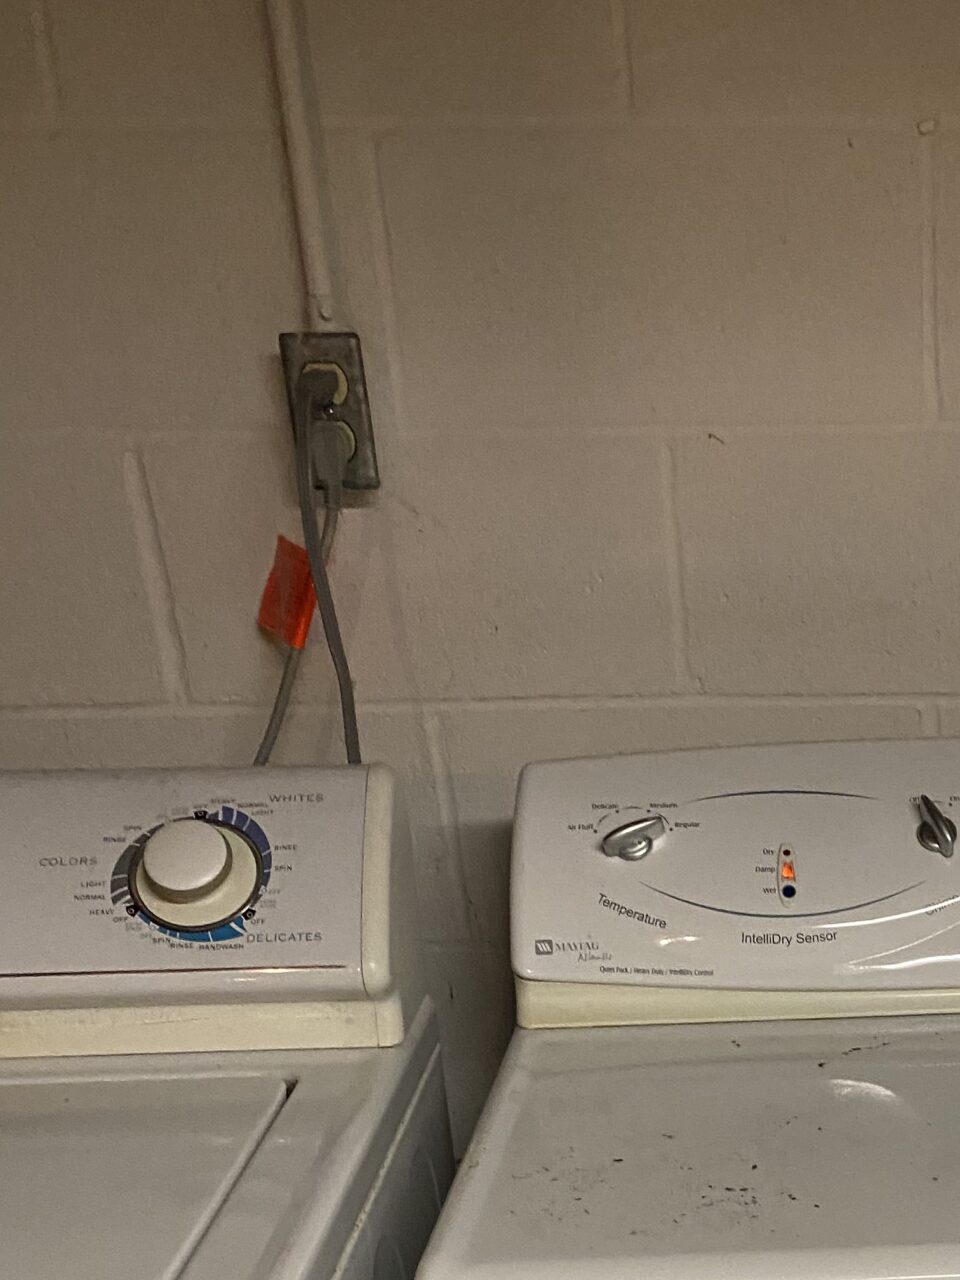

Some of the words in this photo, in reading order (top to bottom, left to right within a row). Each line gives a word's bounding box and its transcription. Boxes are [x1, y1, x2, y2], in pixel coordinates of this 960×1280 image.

[269, 793, 324, 803] WHITES
[39, 857, 97, 867] COLORS
[598, 893, 667, 929] Temperature
[246, 932, 323, 943] DELICATES
[741, 932, 792, 947] IntelliDry
[796, 932, 838, 944] Sensor
[198, 943, 244, 951] HANDWASH
